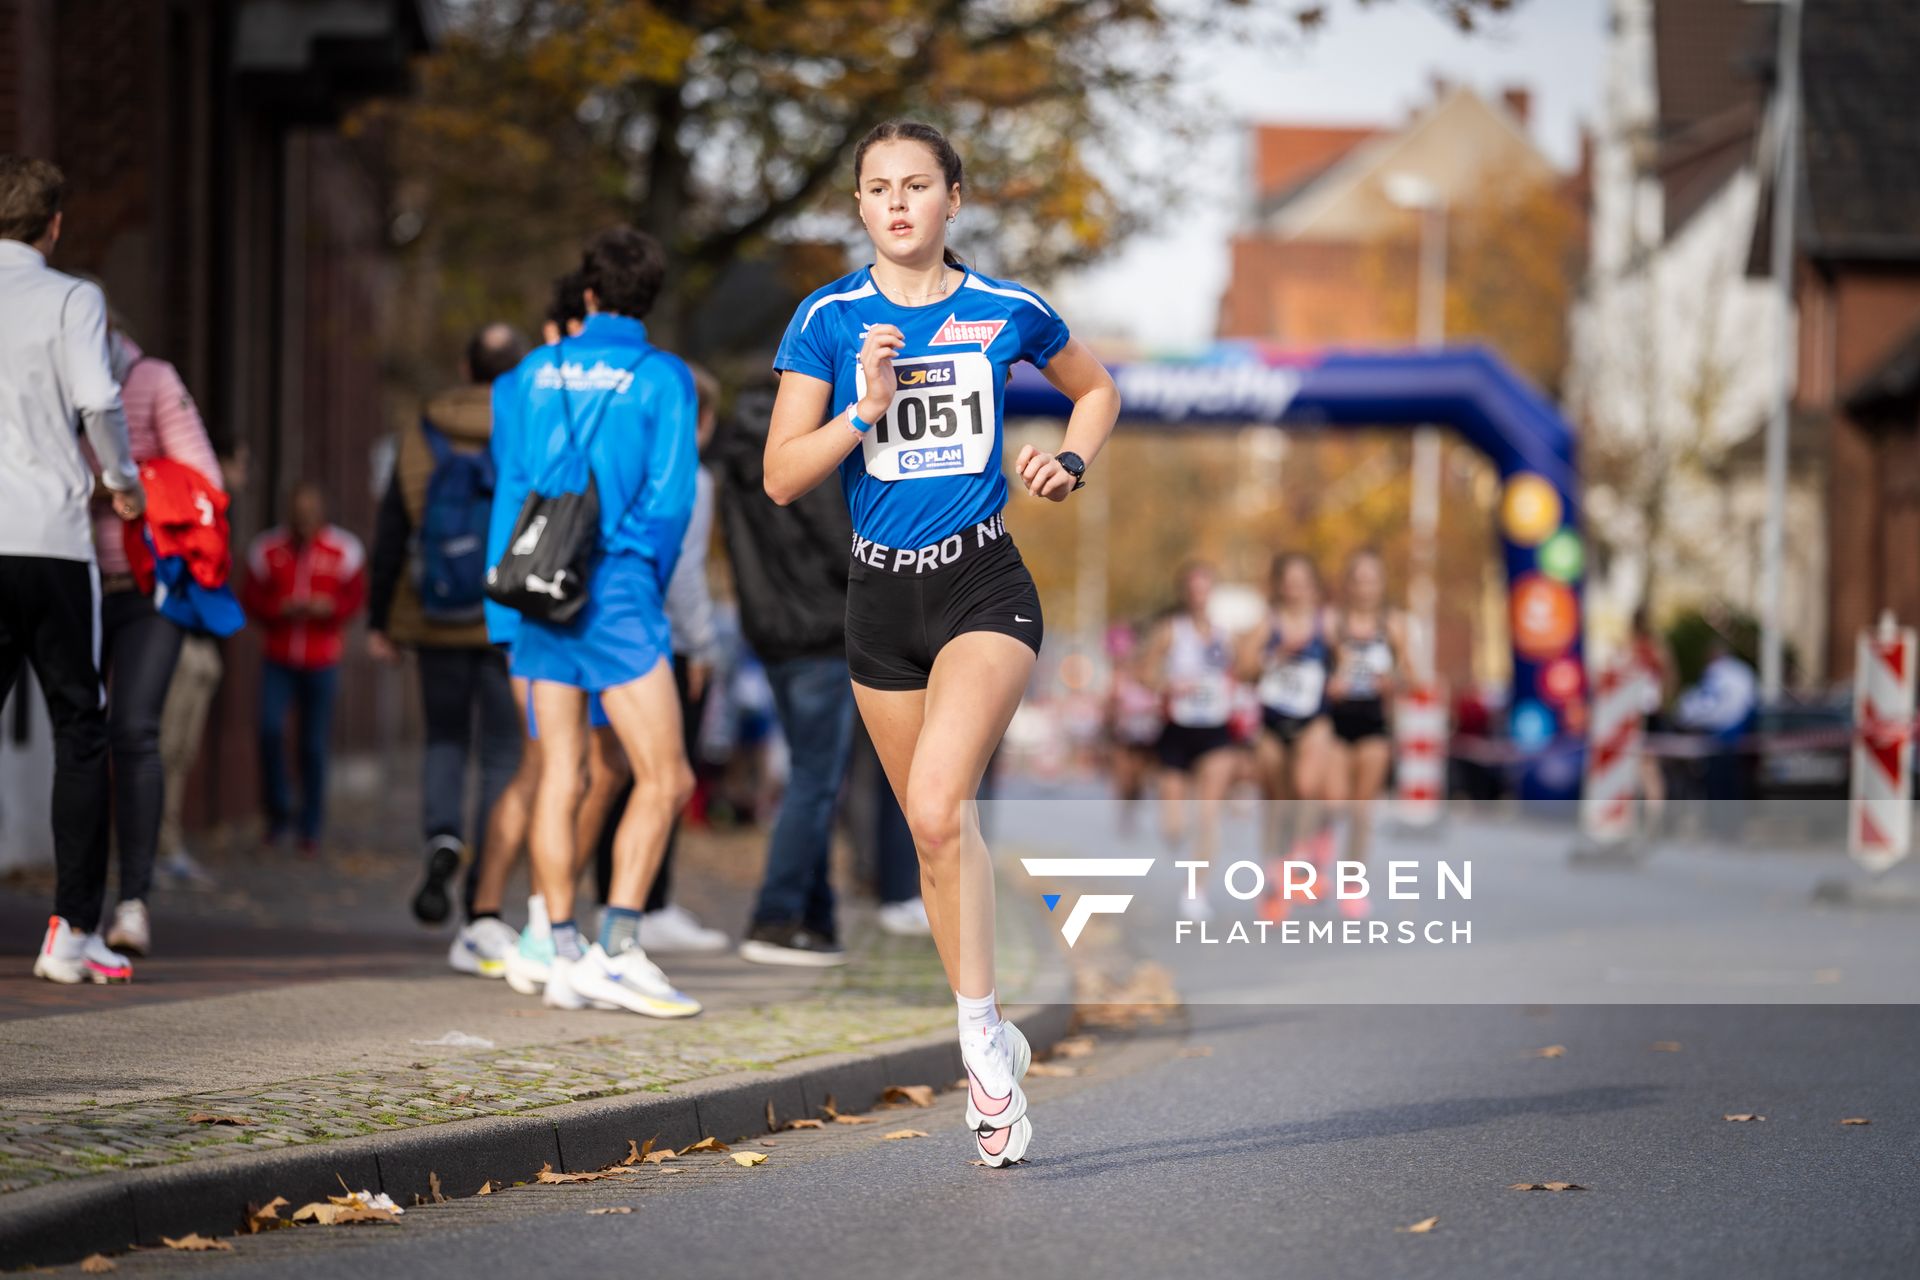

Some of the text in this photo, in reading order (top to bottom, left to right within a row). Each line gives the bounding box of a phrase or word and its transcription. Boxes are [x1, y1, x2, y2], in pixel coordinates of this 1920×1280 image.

[926, 368, 951, 383] GLS
[924, 448, 962, 463] PLAN
[892, 534, 963, 574] PRO
